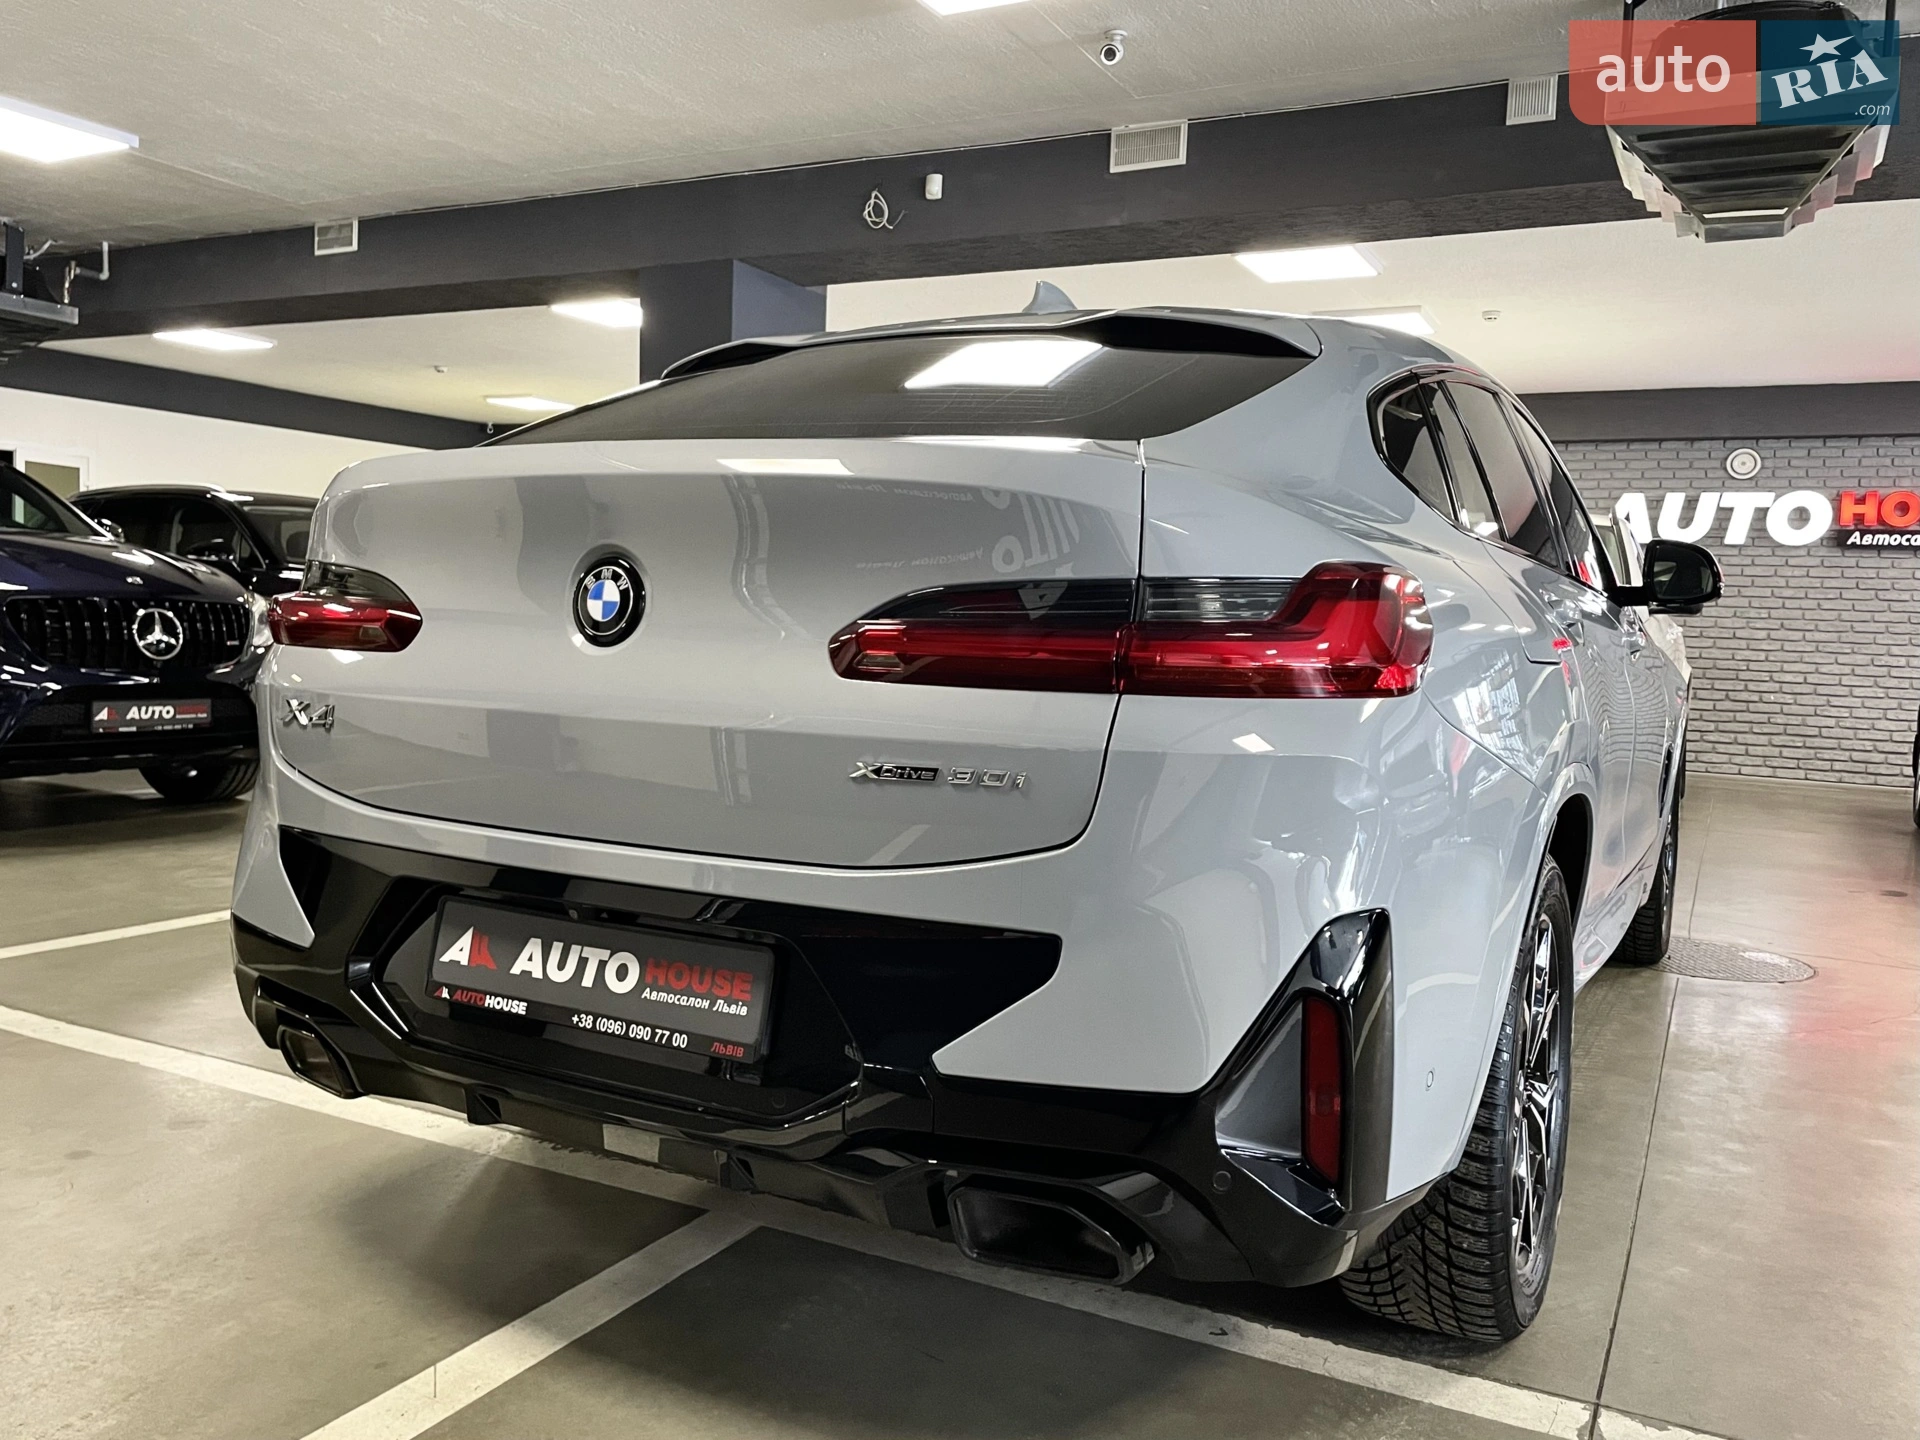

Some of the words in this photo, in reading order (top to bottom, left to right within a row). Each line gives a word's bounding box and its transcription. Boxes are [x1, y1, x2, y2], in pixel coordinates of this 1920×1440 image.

[1614, 490, 1833, 546] AUTO
[584, 568, 630, 591] BMW
[126, 705, 175, 720] AUTO
[281, 699, 335, 729] X4
[509, 937, 640, 995] AUTO
[644, 957, 754, 1001] HOUSE
[641, 987, 711, 1010] Автосалон
[713, 999, 748, 1017] Львів
[571, 1013, 594, 1029] +38
[596, 1016, 627, 1036] (096)
[628, 1023, 651, 1041] 090
[654, 1028, 670, 1044] 77
[672, 1032, 688, 1048] 00
